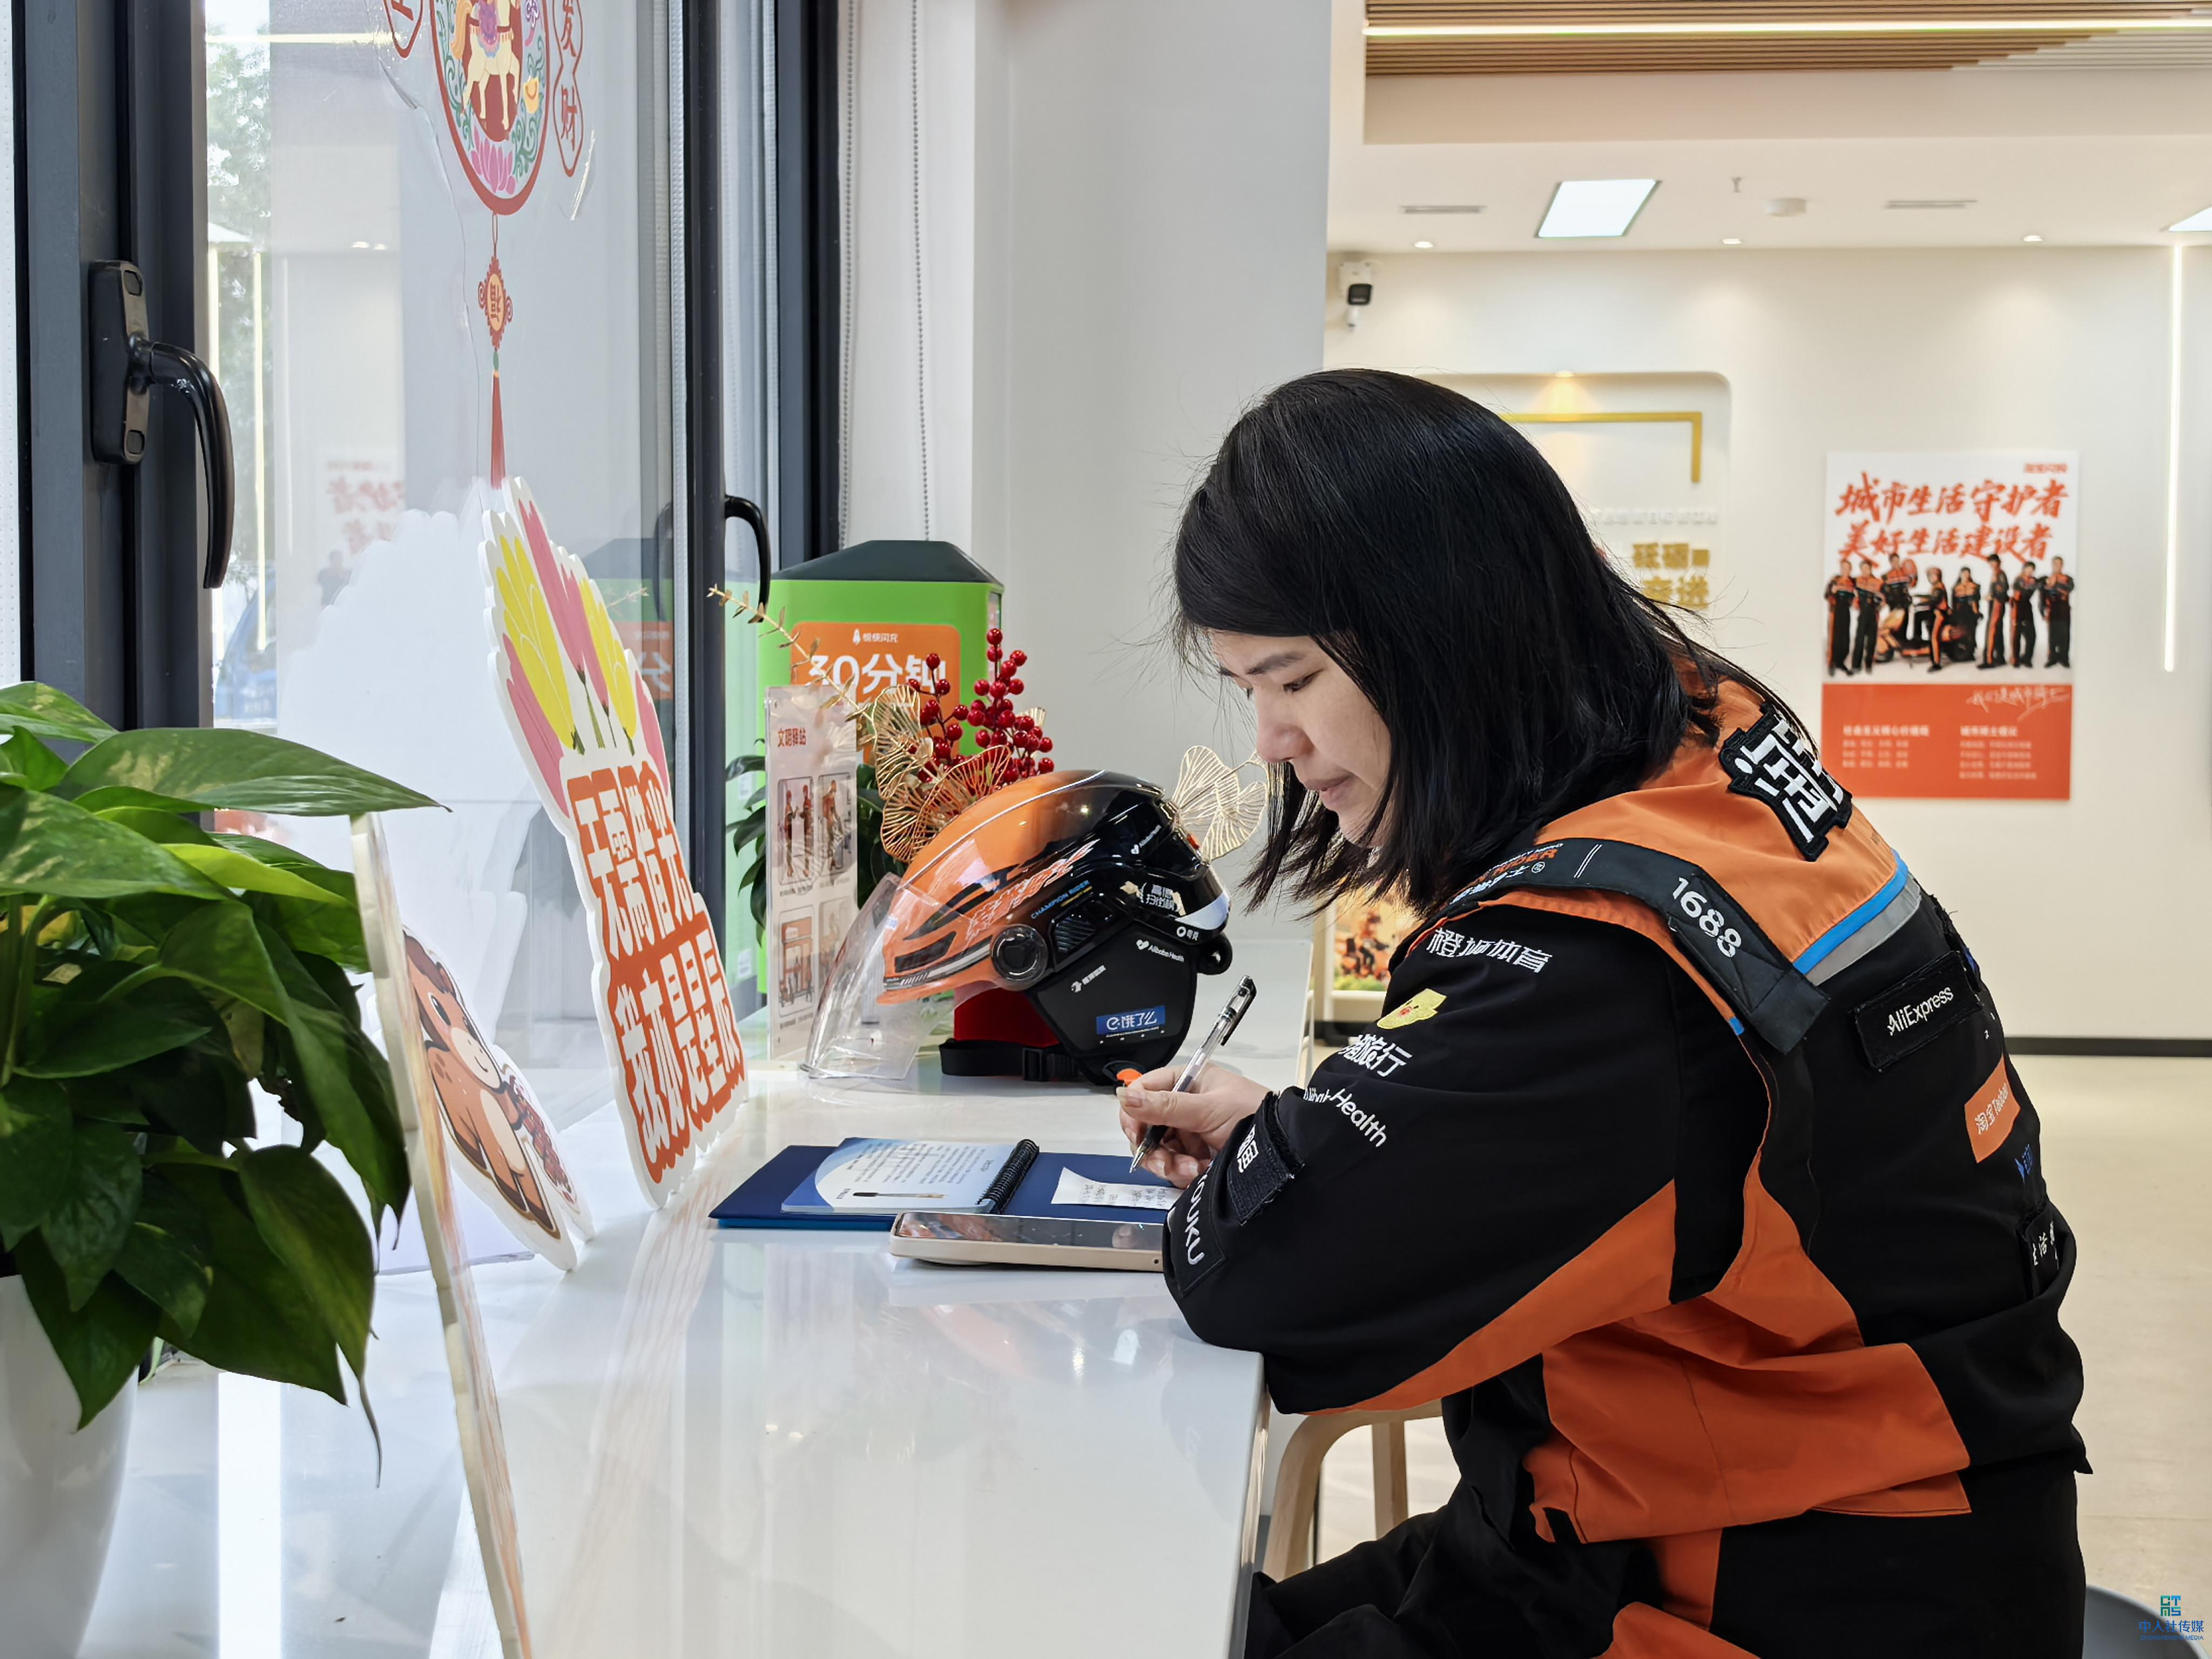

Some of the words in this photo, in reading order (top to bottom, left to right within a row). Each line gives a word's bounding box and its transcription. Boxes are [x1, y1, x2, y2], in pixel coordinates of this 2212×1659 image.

[1834, 471, 2068, 524] 城市生活守护者
[1838, 520, 2053, 568] 美好生活建设者
[1673, 877, 1742, 958] 1688
[1426, 927, 1553, 973] 橙狮体育
[1887, 986, 1954, 1036] AliExpress
[1330, 1088, 1387, 1147] Health
